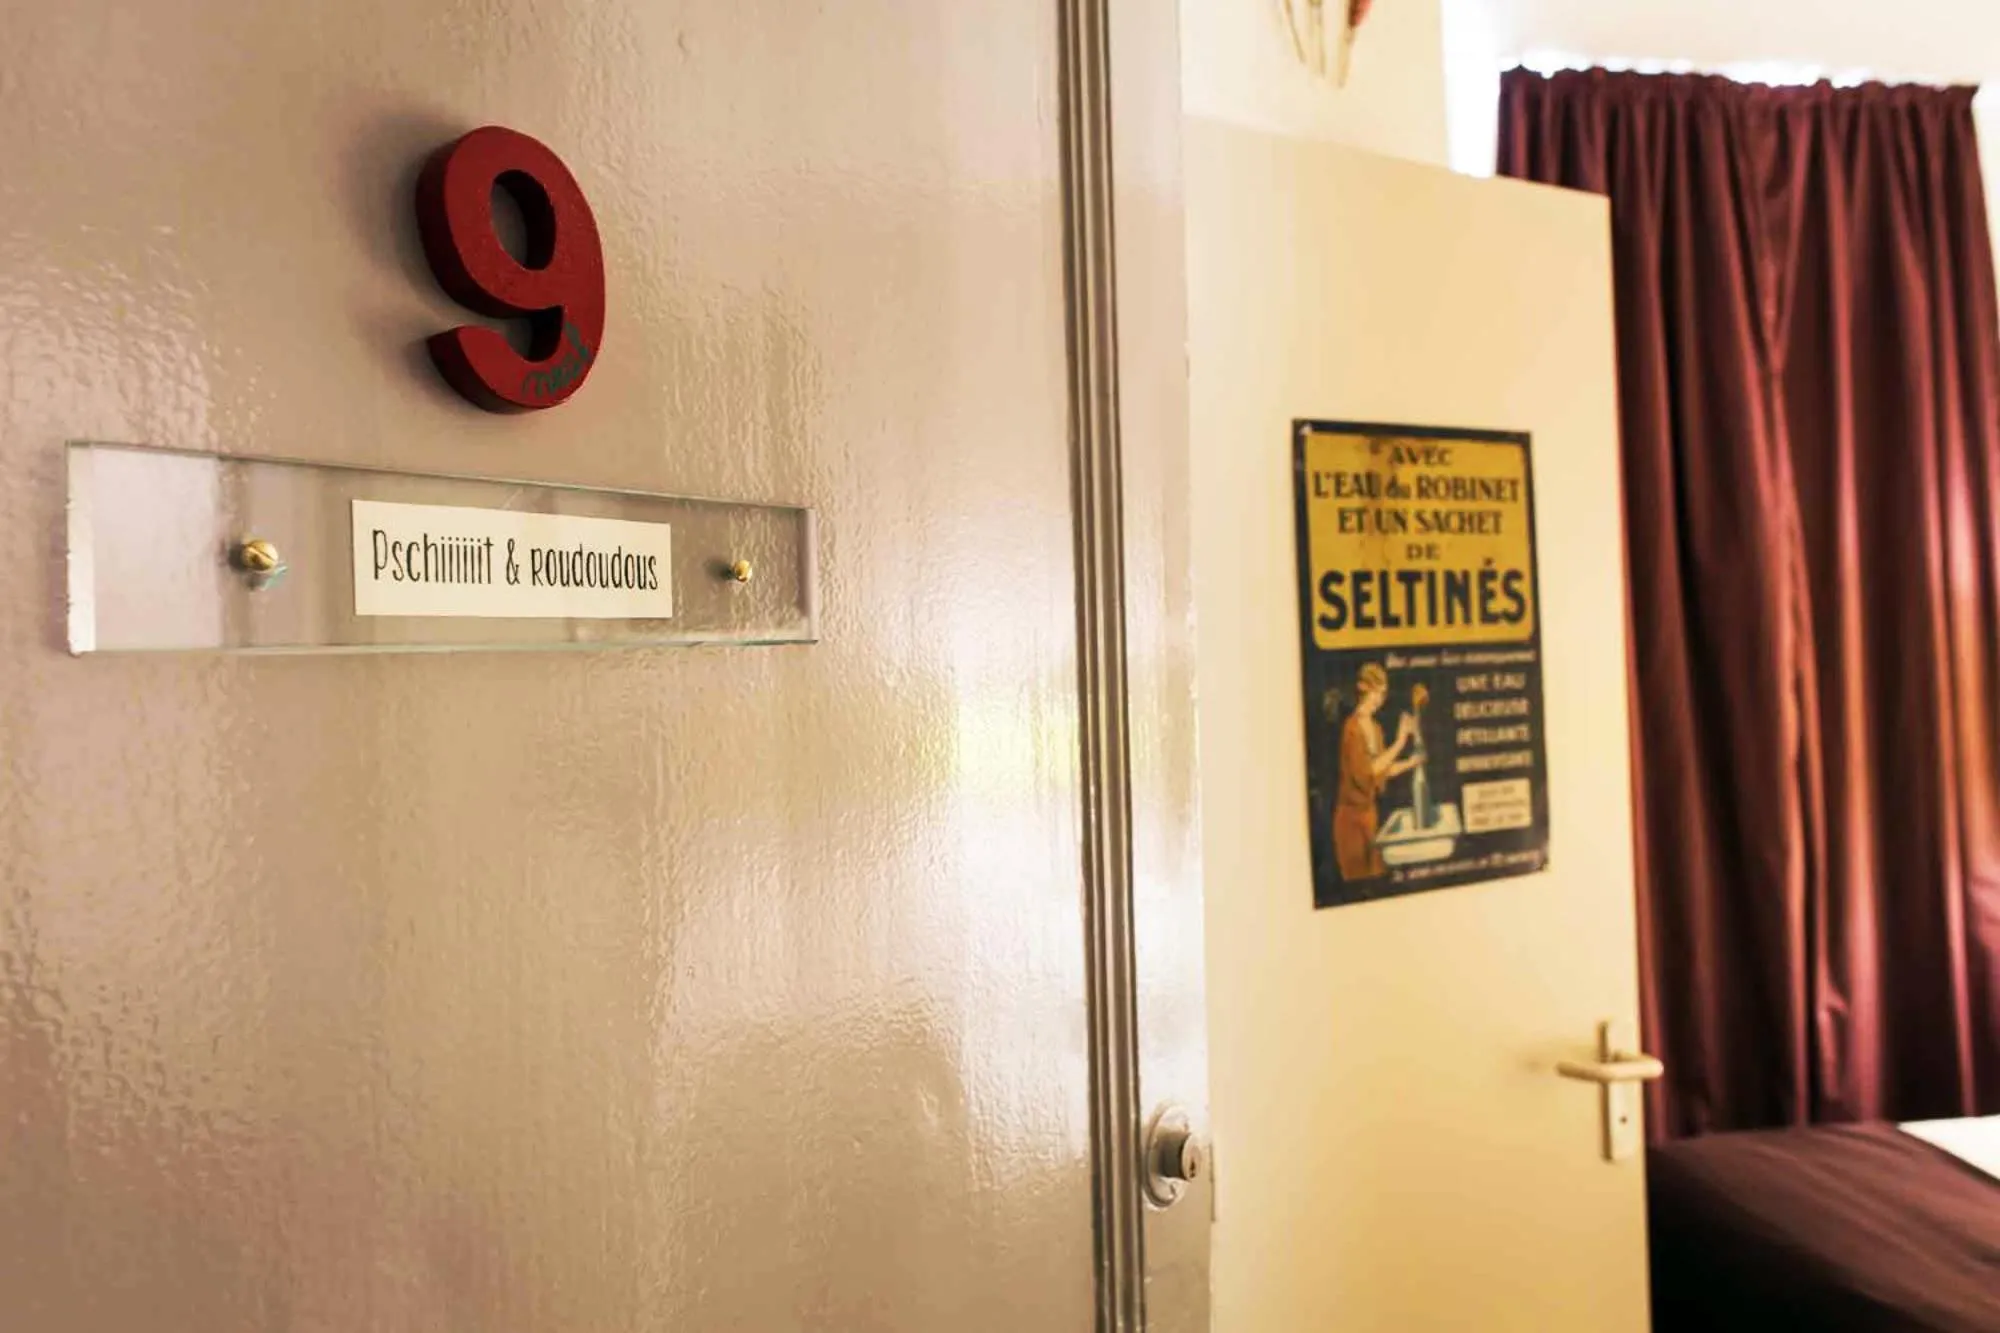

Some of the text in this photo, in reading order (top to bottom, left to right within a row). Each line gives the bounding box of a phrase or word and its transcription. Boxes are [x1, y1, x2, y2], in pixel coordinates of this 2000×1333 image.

[416, 125, 606, 413] 9
[1390, 446, 1453, 466] AVEC
[1312, 471, 1381, 499] L'EAU
[1416, 475, 1520, 502] ROBINET
[1337, 507, 1504, 534] ET UN SACHET
[505, 537, 521, 586] &
[1406, 543, 1441, 561] DE
[1317, 557, 1527, 631] SELTINÉS
